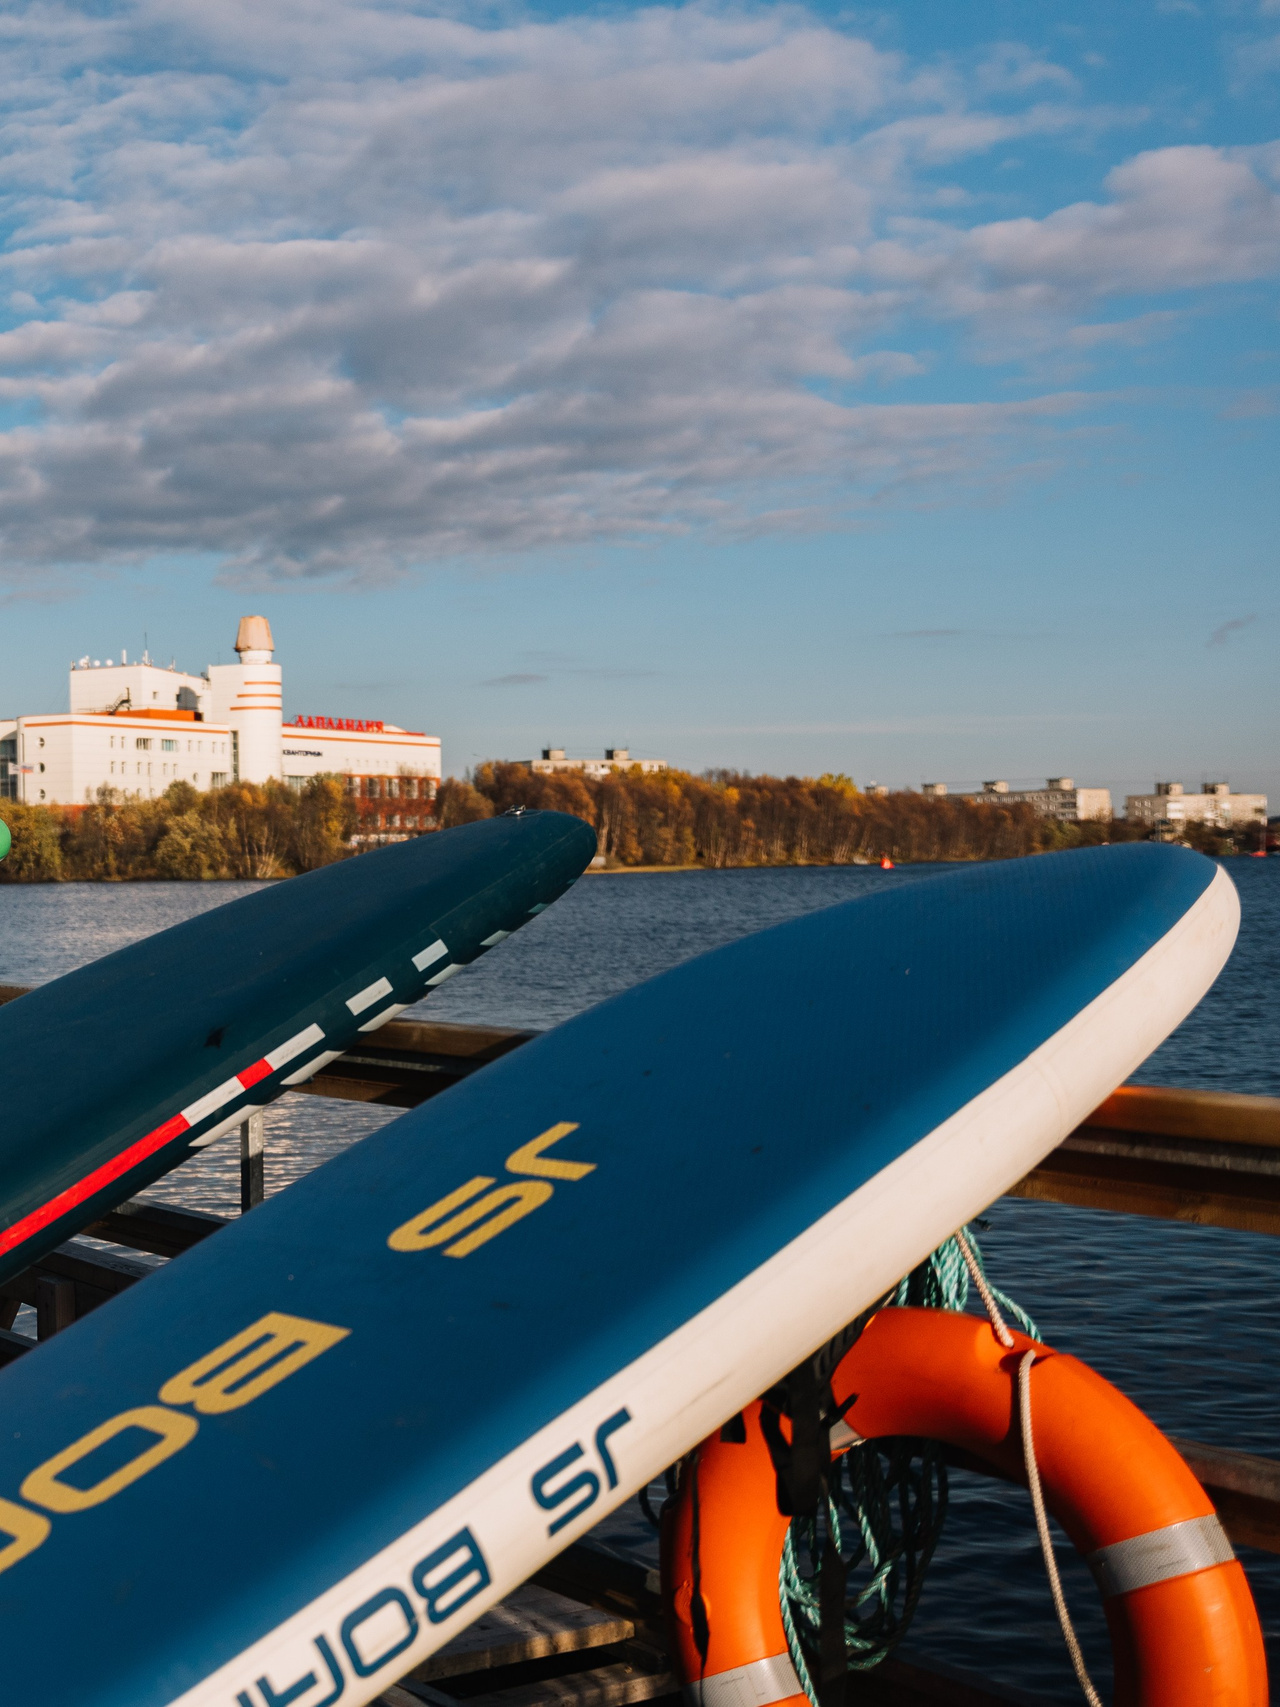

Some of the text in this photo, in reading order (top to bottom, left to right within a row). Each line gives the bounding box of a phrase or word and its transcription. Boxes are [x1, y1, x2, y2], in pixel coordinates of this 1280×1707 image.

[295, 714, 384, 733] ЛАПЛАНДИЯ
[387, 1121, 597, 1259] JS
[236, 1406, 634, 1707] JS BOA
